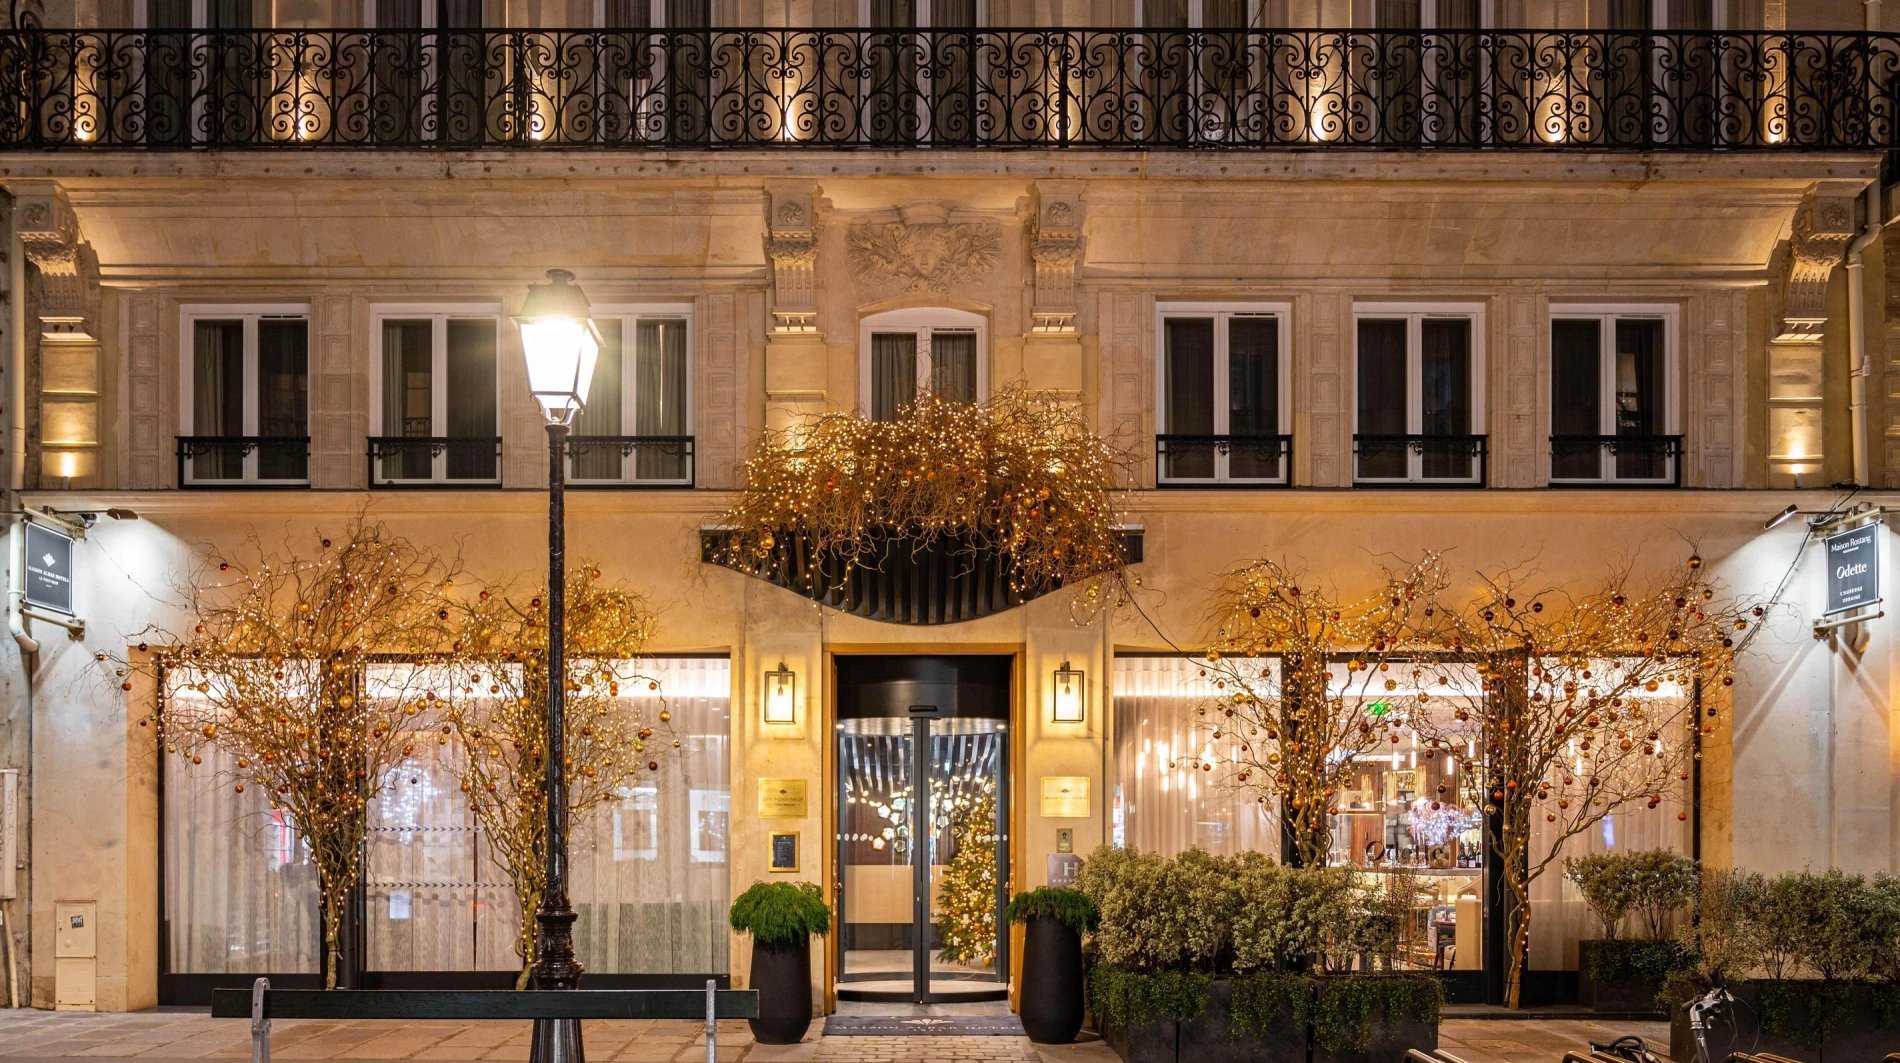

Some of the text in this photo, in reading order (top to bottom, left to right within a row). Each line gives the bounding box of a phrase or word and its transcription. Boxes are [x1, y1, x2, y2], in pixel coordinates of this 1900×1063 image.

[1831, 542, 1849, 552] Maison
[1850, 536, 1871, 547] Rostang
[1836, 563, 1867, 579] Odette
[1063, 862, 1079, 876] H
